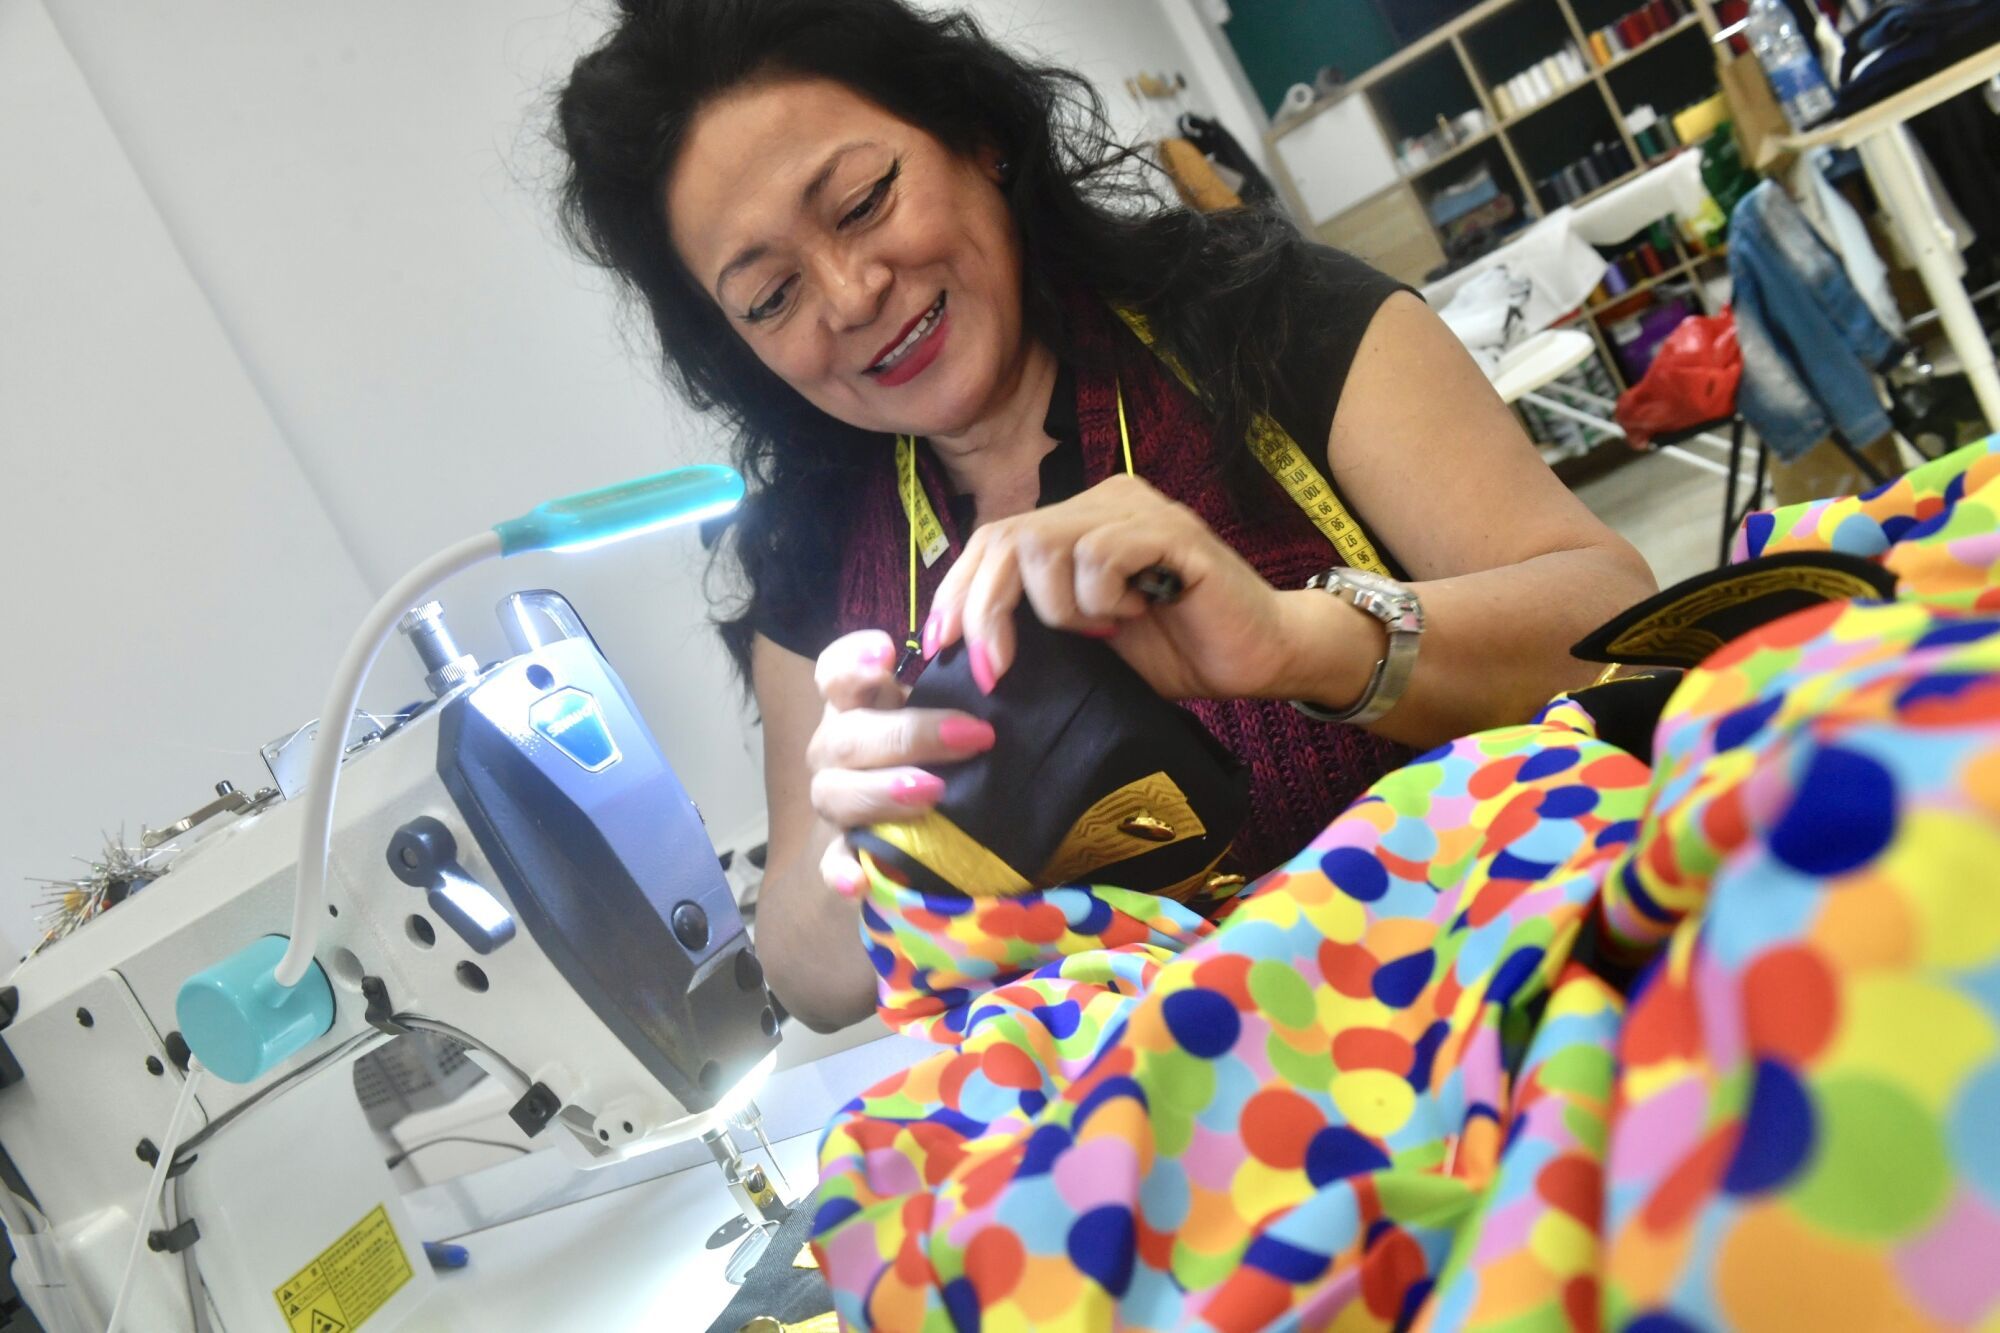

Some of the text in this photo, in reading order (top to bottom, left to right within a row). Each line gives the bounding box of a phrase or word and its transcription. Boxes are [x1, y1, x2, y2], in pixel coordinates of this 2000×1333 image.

[1276, 453, 1296, 470] 102
[1291, 470, 1308, 485] 101
[1303, 486, 1320, 500] 100
[1318, 501, 1332, 515] 99
[1330, 518, 1345, 532] 98
[1345, 534, 1358, 548] 97
[1356, 551, 1370, 564] 96
